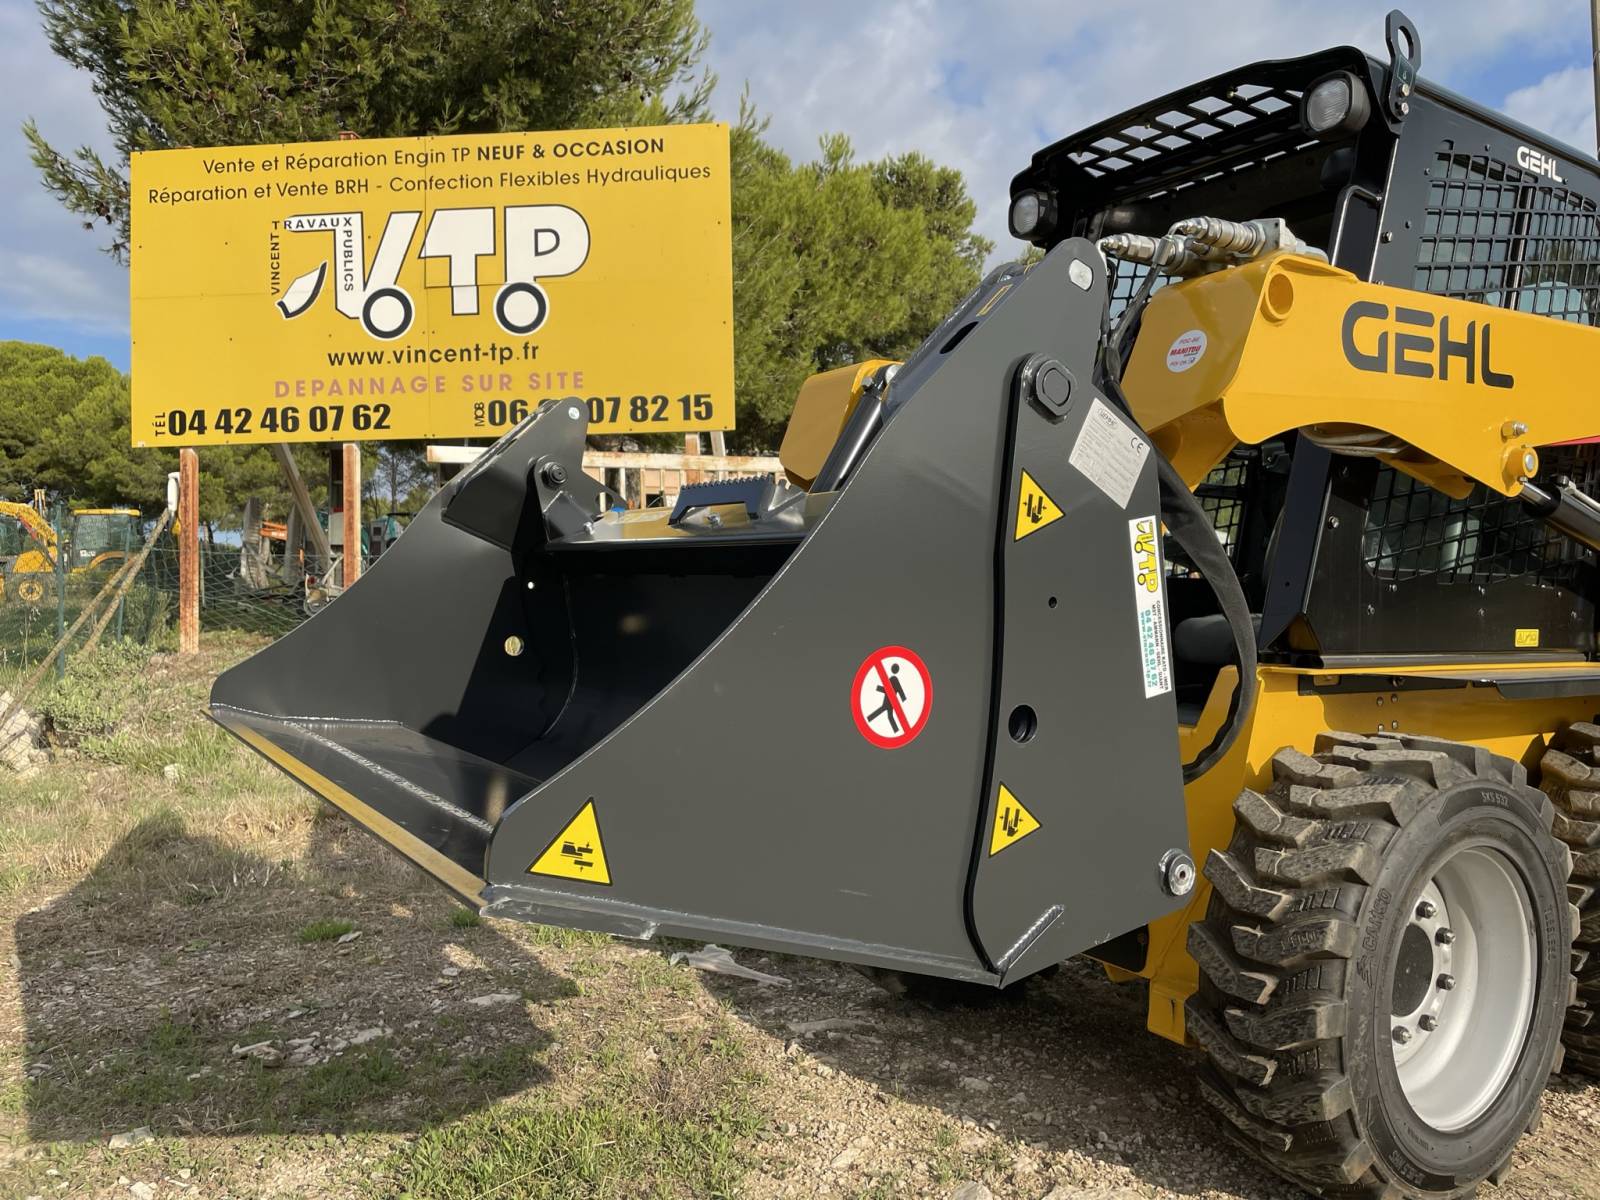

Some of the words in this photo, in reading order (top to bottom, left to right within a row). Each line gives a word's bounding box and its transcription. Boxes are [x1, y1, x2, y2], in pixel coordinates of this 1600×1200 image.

[203, 158, 254, 174] Vente
[262, 156, 278, 171] et
[286, 152, 386, 172] Réparation
[395, 149, 444, 168] Engin
[452, 148, 470, 162] TP
[478, 145, 524, 160] NEUF
[532, 144, 544, 158] &
[553, 138, 664, 158] OCCASION
[1517, 146, 1562, 182] GEHL
[149, 186, 246, 206] Réparation
[254, 184, 271, 198] et
[276, 181, 328, 196] Vente
[336, 179, 368, 194] BRH
[390, 174, 492, 192] Confection
[500, 171, 580, 187] Flexibles
[588, 166, 710, 186] Hydrauliques
[272, 217, 352, 230] TRAVAUX
[270, 233, 280, 296] VINCENT
[343, 230, 354, 292] PUBLICS
[328, 341, 539, 366] www.vincent-tp.fr
[1342, 301, 1514, 388] GEHL
[274, 376, 446, 398] DEPANNAGE
[462, 374, 512, 392] SUR
[528, 372, 584, 391] SITE
[168, 410, 207, 436] 04
[214, 408, 252, 434] 42
[260, 406, 300, 432] 46
[309, 405, 344, 432] 07
[352, 404, 391, 430] 62
[488, 399, 528, 426] 06
[587, 397, 620, 424] 07
[630, 395, 669, 422] 82
[677, 394, 713, 421] 15
